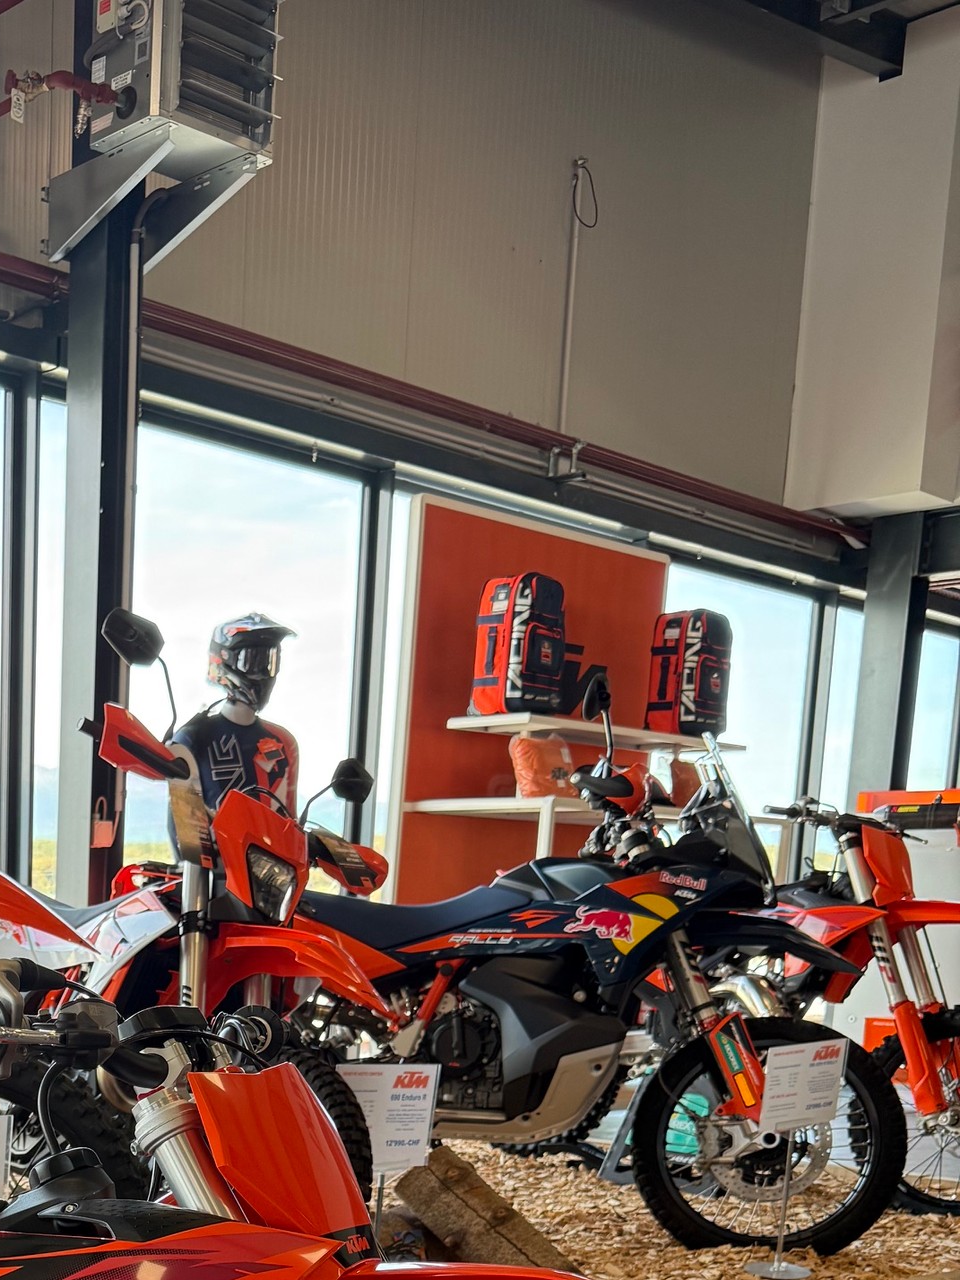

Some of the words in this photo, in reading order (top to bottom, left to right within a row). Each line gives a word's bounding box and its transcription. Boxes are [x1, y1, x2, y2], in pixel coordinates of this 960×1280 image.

[659, 870, 682, 887] Red
[681, 872, 707, 891] Bull
[449, 933, 514, 946] RALLY
[812, 1044, 841, 1062] KTM
[393, 1071, 430, 1089] KTM
[401, 1093, 422, 1102] Enduro
[345, 1234, 372, 1254] KTM
